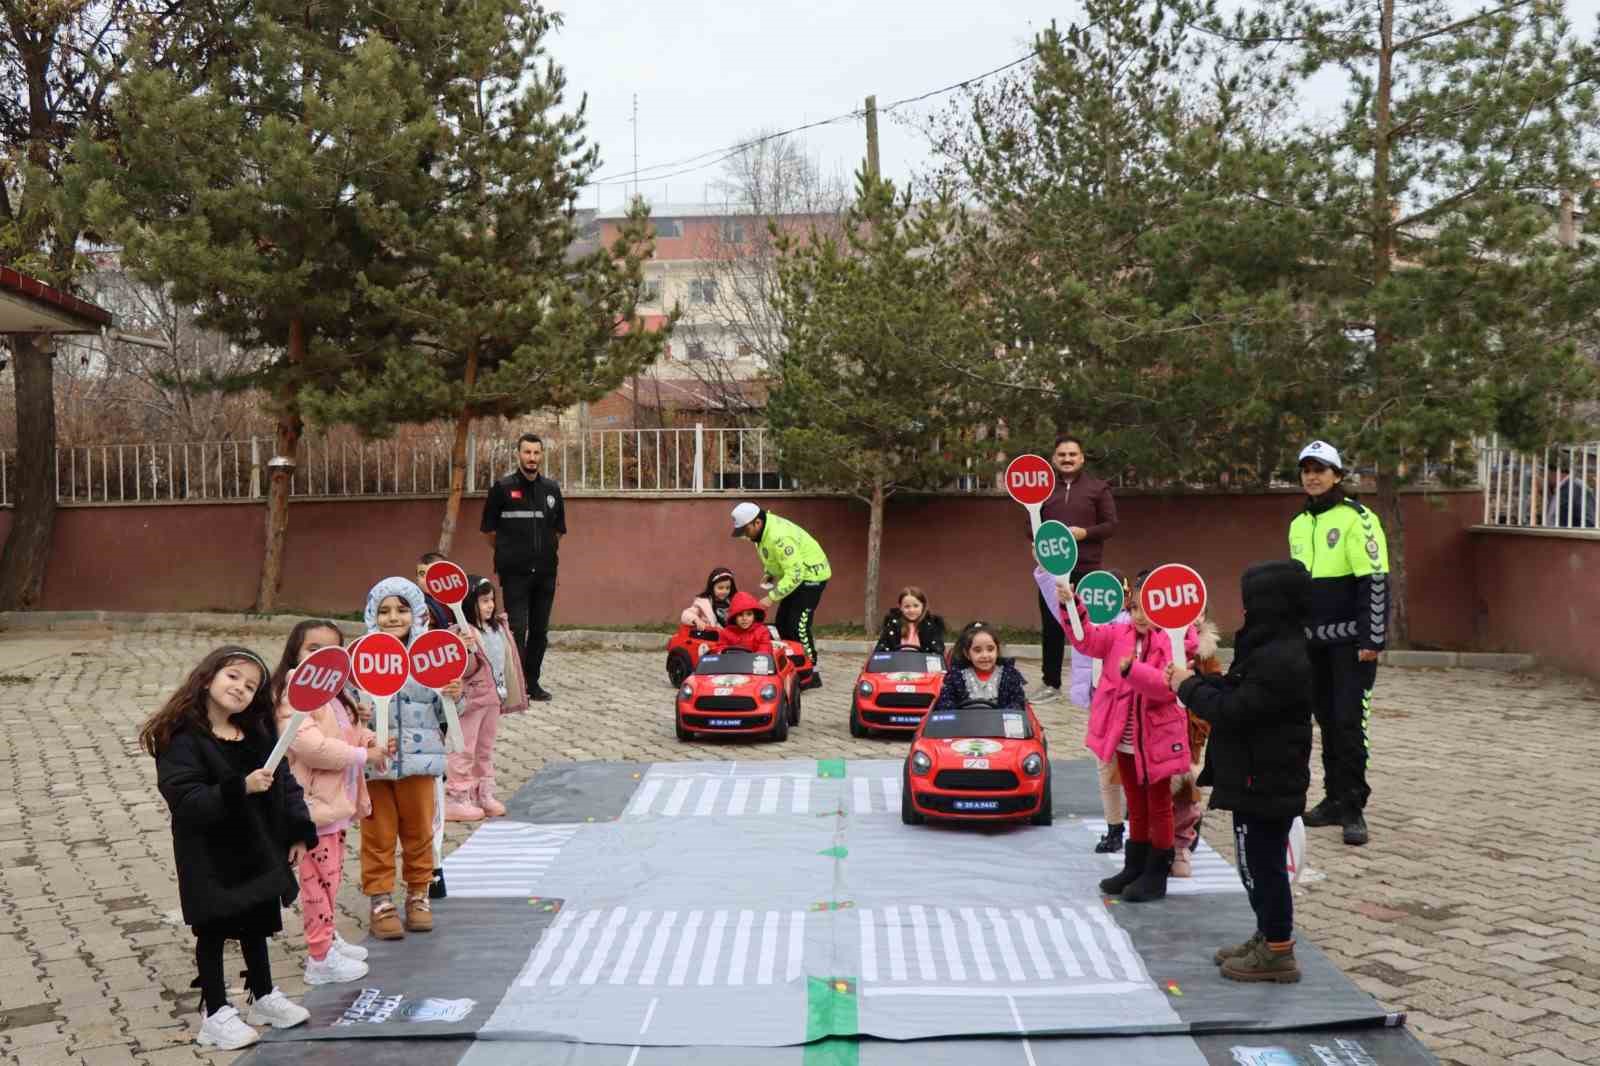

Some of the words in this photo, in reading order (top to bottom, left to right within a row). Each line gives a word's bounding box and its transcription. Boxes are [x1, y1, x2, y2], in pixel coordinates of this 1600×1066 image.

[1010, 470, 1049, 488] DUR
[1038, 537, 1070, 559] GEÇ
[429, 574, 463, 593] DUR
[1080, 588, 1118, 611] GEÇ
[1148, 583, 1199, 611] DUR
[360, 652, 403, 675] DUR
[413, 643, 461, 673] DUR
[296, 664, 342, 692] DUR
